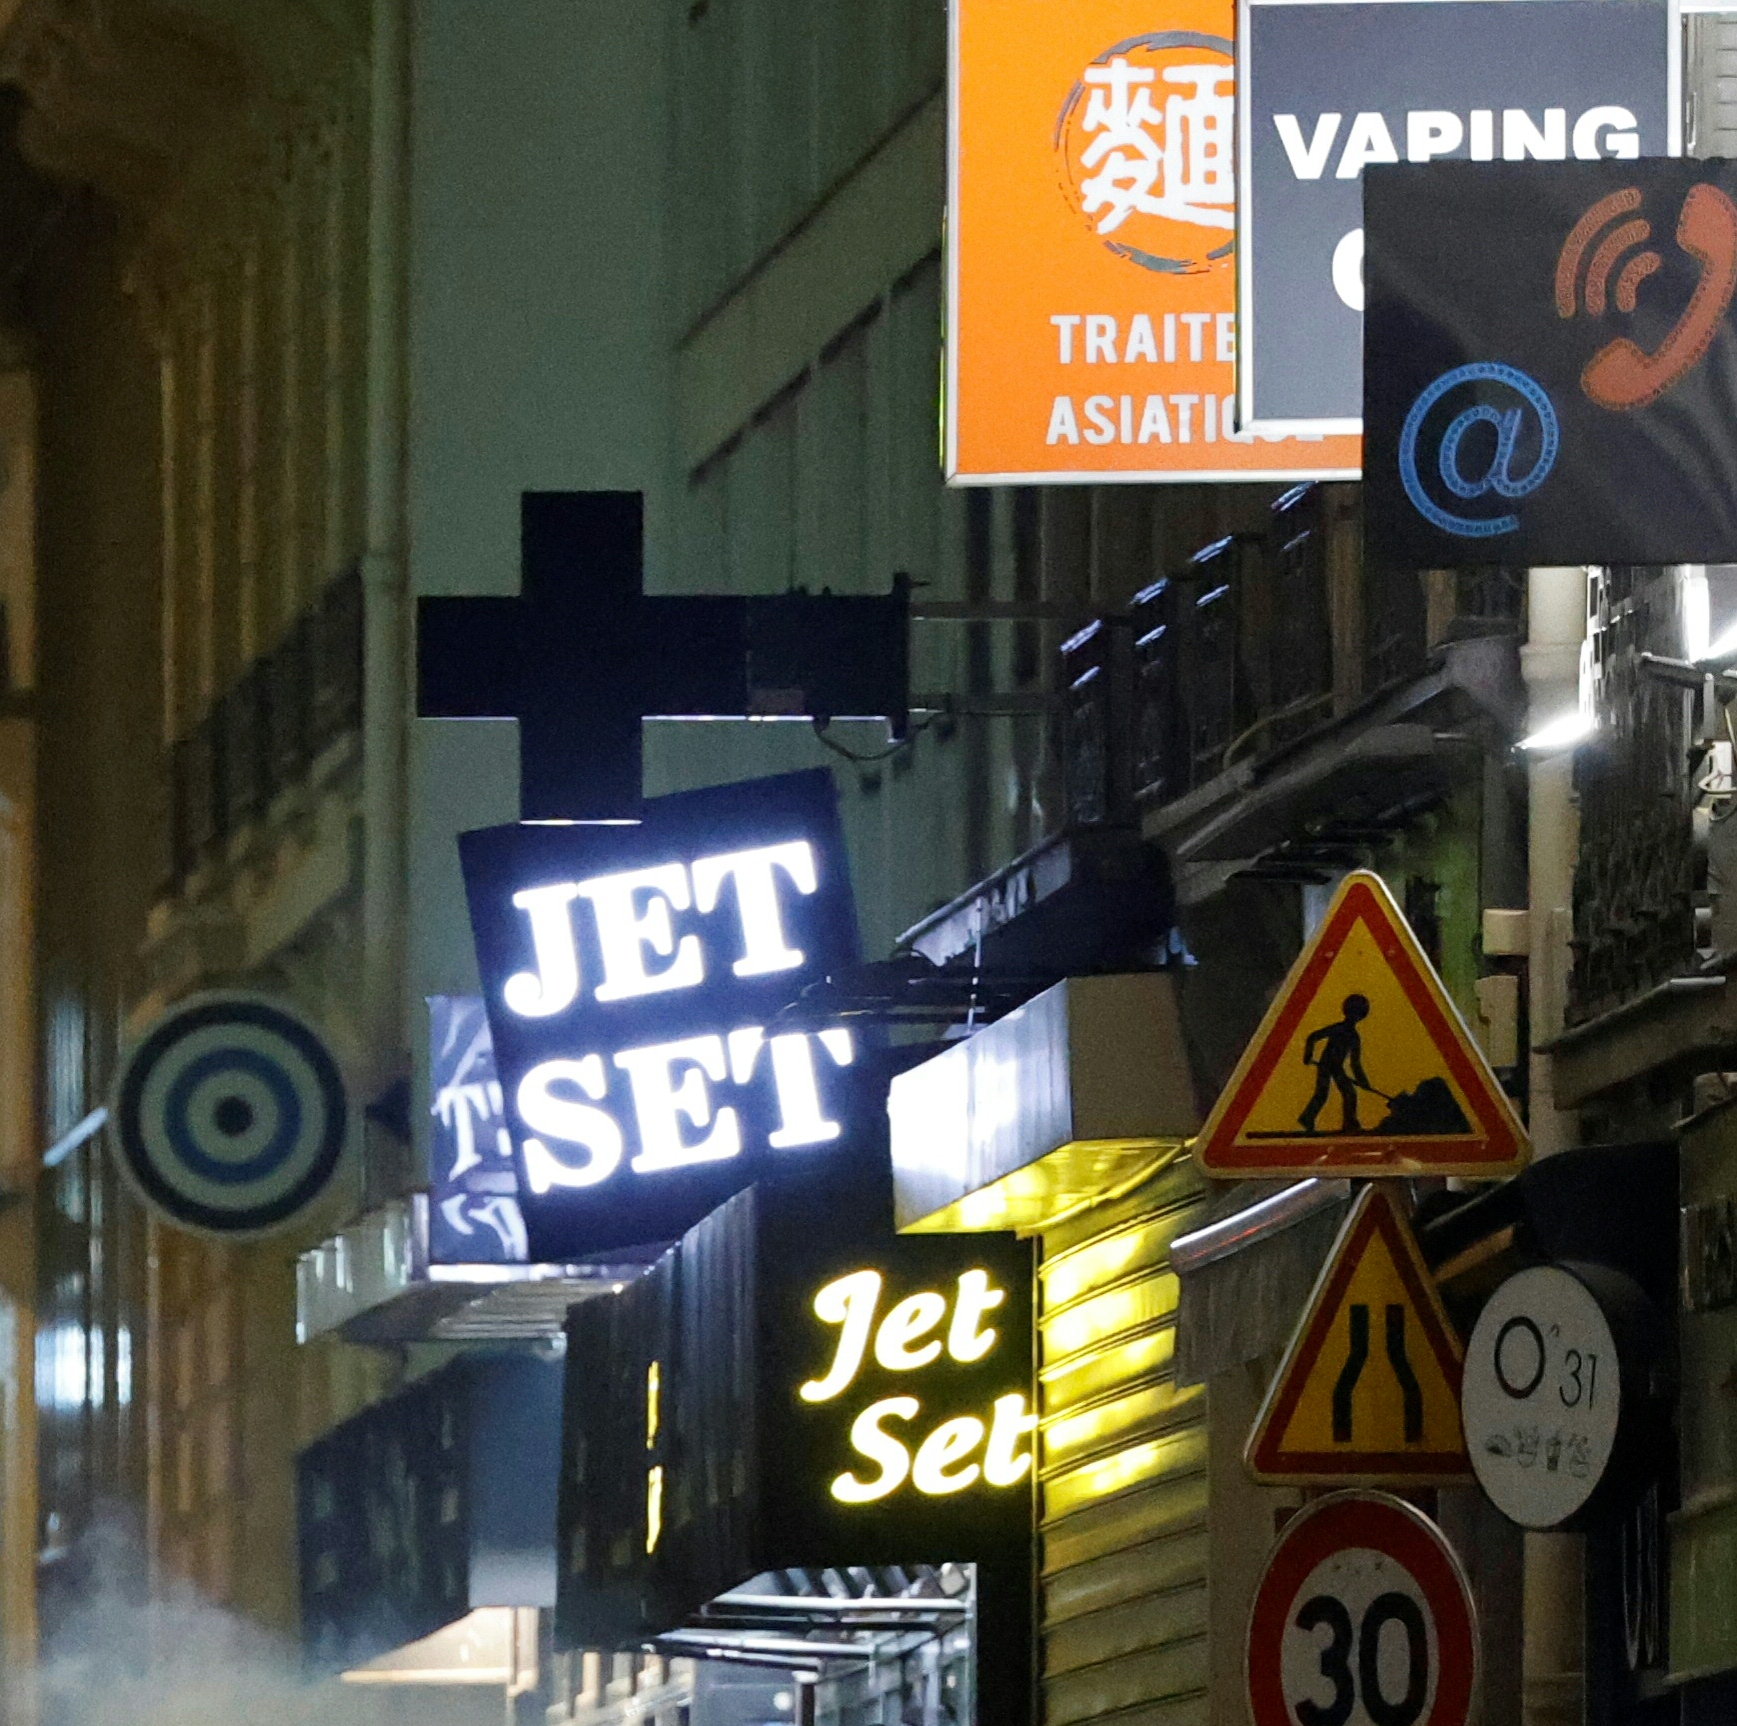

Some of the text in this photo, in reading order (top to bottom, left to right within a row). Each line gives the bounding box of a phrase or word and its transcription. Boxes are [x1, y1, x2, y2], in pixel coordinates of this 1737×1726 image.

[1273, 106, 1639, 180] VAPING
[1046, 394, 1323, 445] ASIATI
[505, 842, 816, 1017] JET
[517, 1027, 853, 1194] SET
[800, 1270, 1005, 1402] Jet
[831, 1393, 1040, 1502] Set
